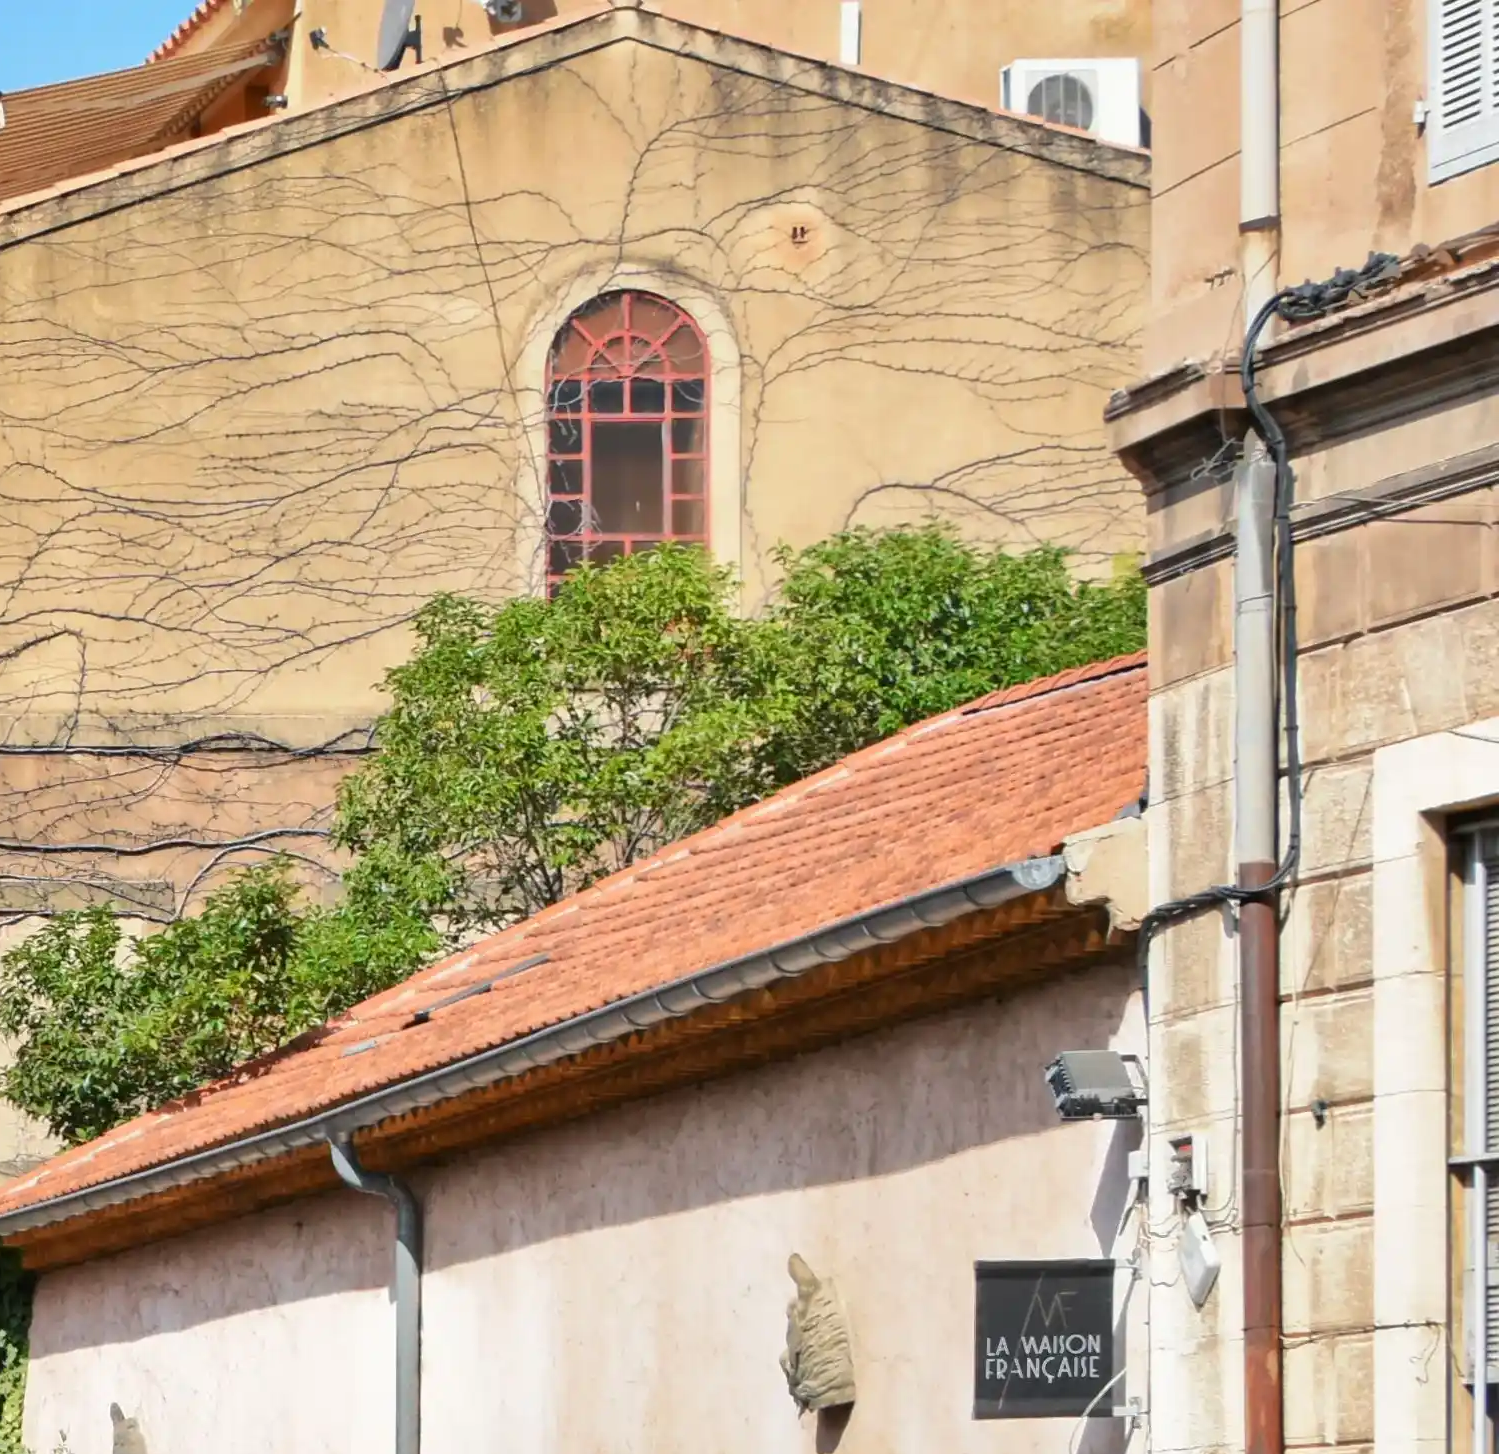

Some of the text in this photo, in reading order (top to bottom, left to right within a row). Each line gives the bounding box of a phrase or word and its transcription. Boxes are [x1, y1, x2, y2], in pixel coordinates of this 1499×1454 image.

[986, 1333, 1101, 1357] LA MAISON
[985, 1355, 1101, 1384] FRANÇAISE
